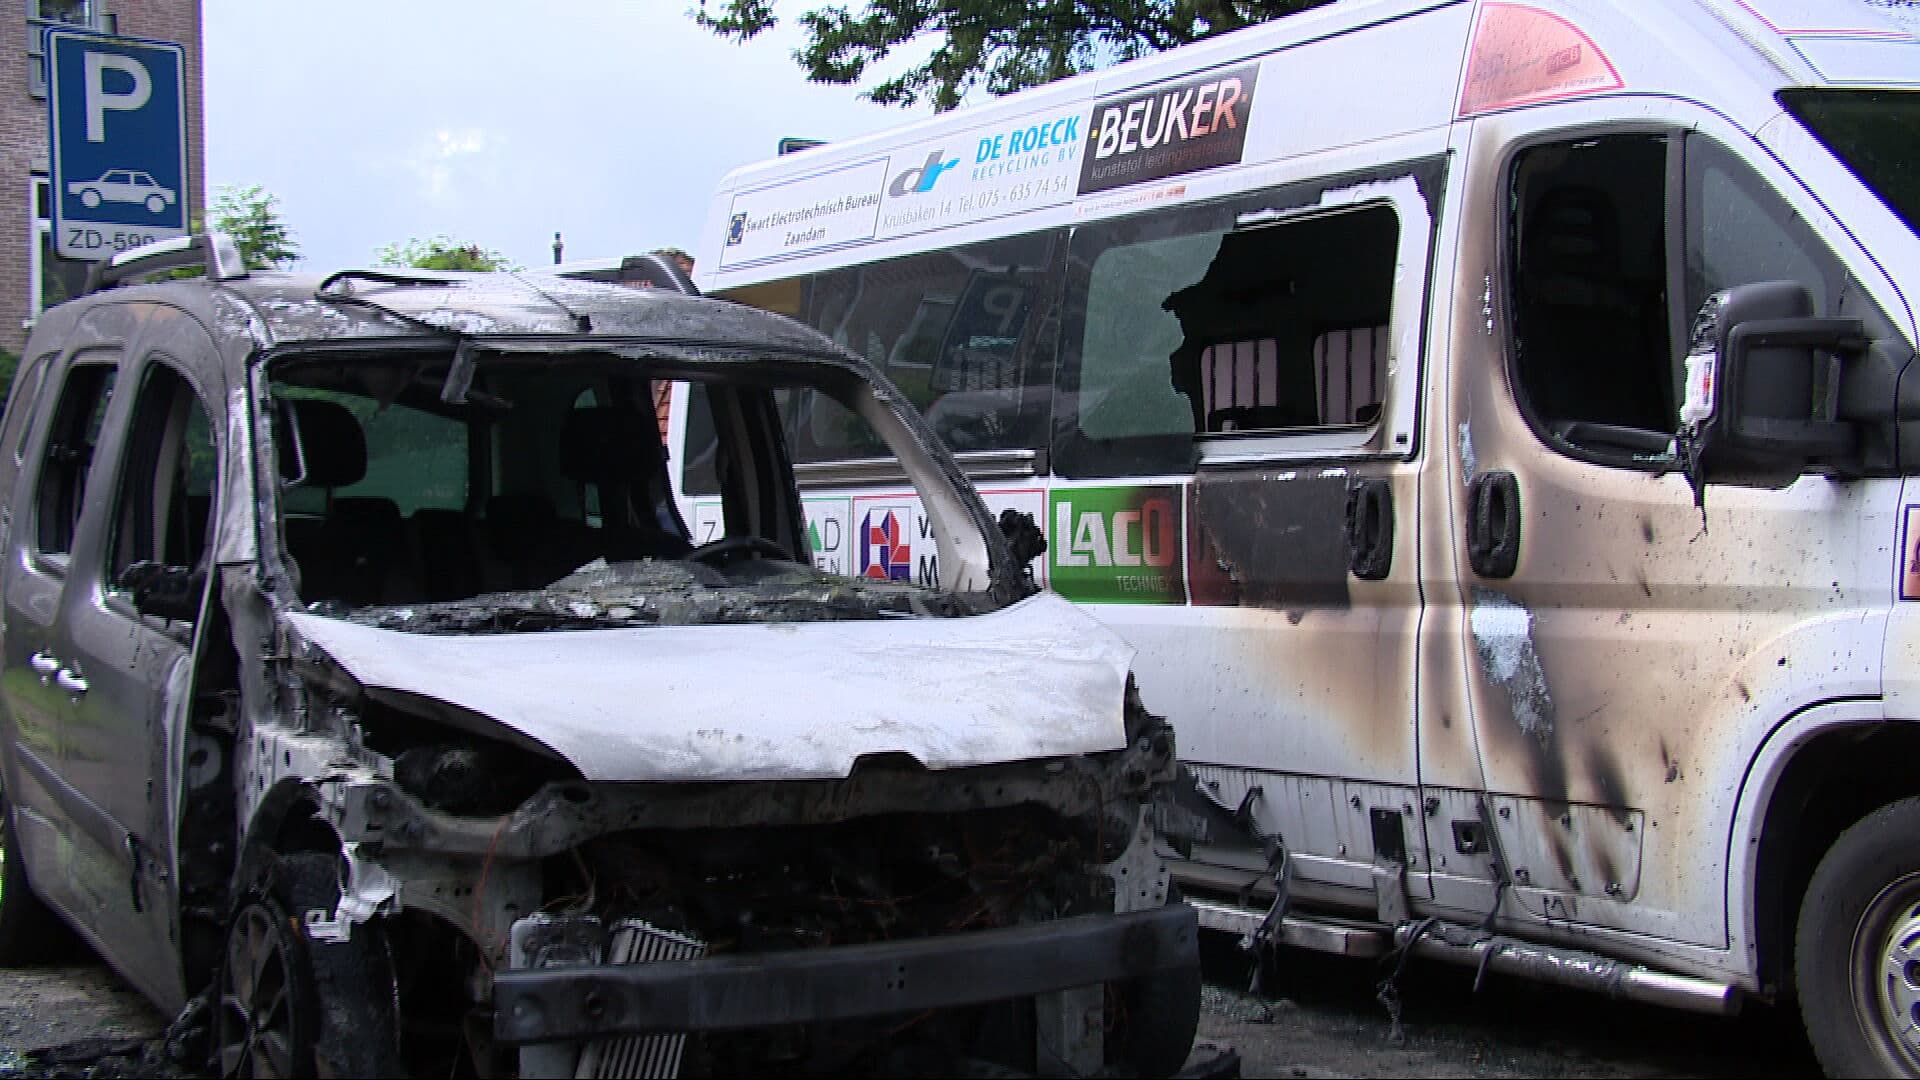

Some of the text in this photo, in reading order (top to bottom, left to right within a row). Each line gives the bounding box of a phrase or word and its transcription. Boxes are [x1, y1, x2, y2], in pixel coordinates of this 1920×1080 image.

[84, 51, 152, 143] P
[1095, 78, 1242, 160] BEUKER
[971, 145, 1077, 182] RECYCLING BV
[976, 115, 1080, 164] DE ROECK
[745, 193, 879, 233] Swart Electrotechnisch Bureau
[882, 207, 936, 232] Kruisbaken
[939, 201, 953, 217] 14
[959, 194, 976, 213] Tel.
[978, 190, 999, 209] 075
[1010, 181, 1031, 203] 635
[1033, 178, 1050, 198] 74
[1053, 175, 1069, 193] 54
[784, 227, 826, 247] Zaandam
[1055, 499, 1176, 568] LACO
[1116, 575, 1174, 593] TECHNIEK
